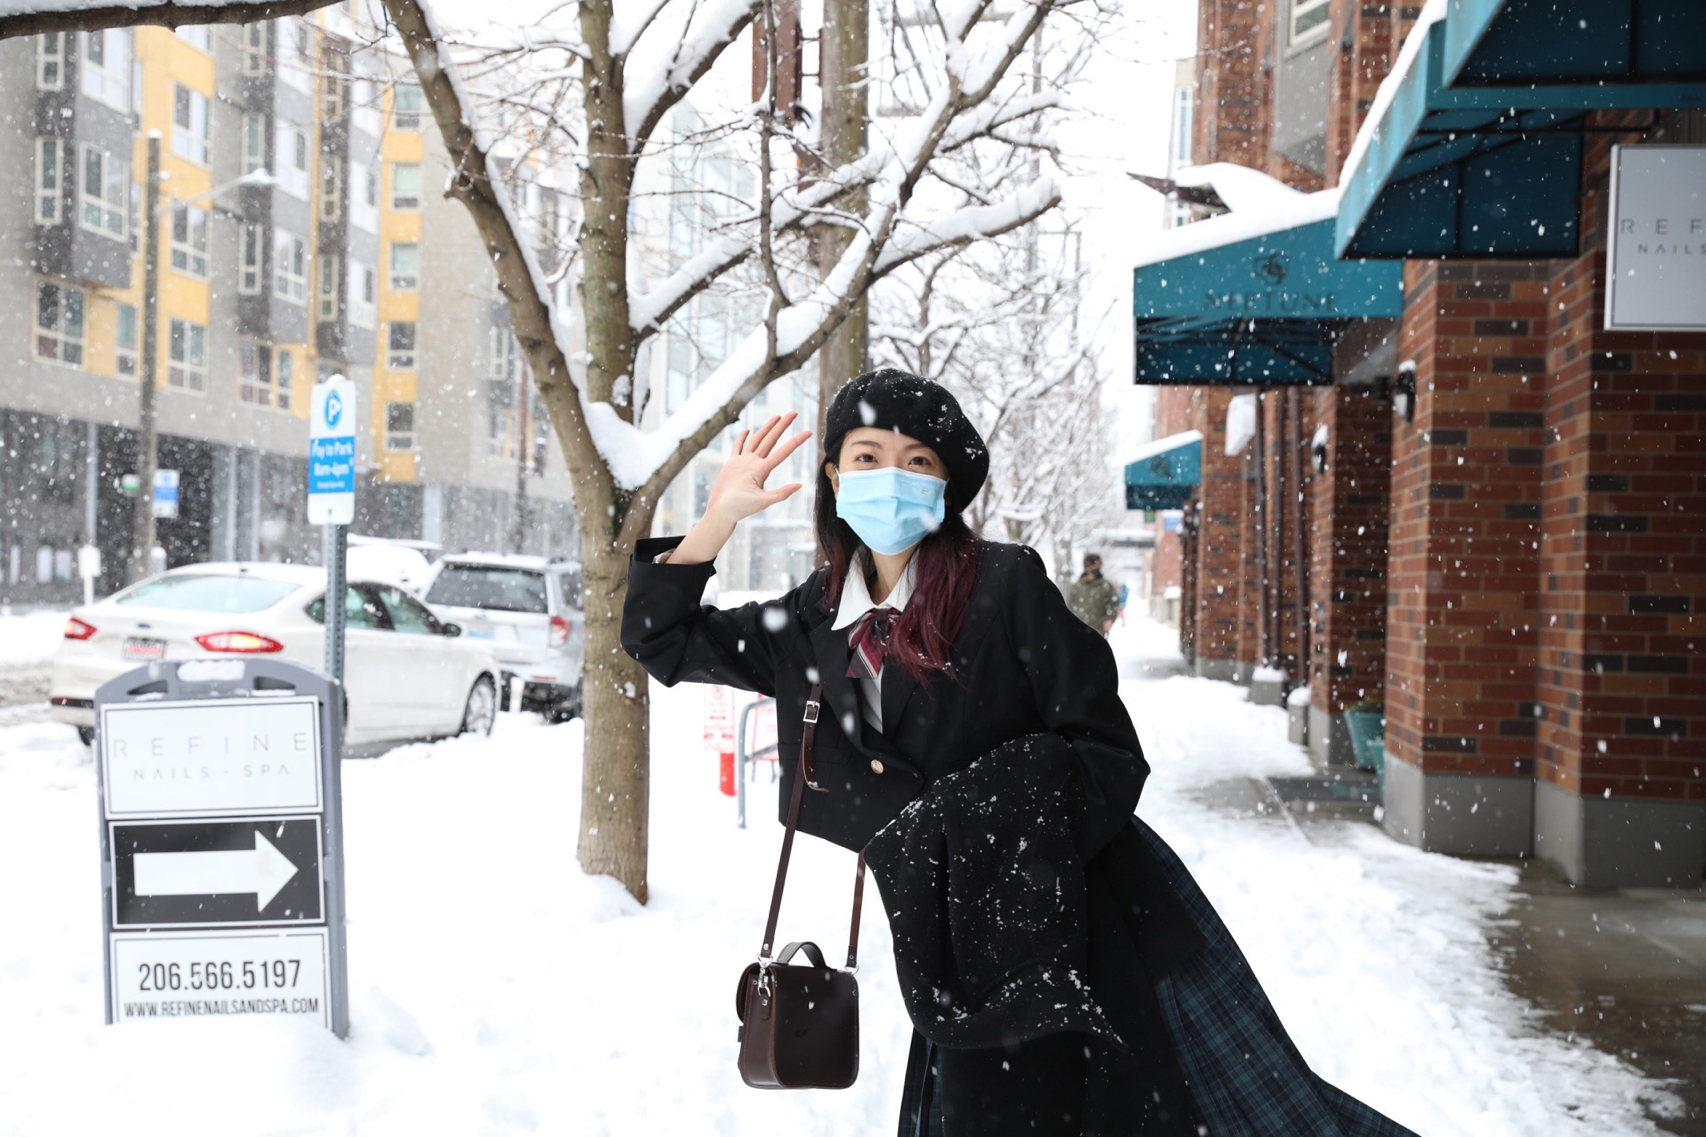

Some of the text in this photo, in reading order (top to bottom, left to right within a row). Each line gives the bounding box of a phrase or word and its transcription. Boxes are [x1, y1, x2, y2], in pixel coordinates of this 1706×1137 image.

[1620, 218, 1703, 235] REF
[1203, 290, 1338, 313] NEPTUNE
[312, 441, 352, 460] Pay to Park
[113, 732, 308, 758] REFINE
[133, 766, 211, 781] NAILS
[244, 764, 289, 778] SPA
[138, 959, 301, 992] 206.566.5197
[124, 998, 319, 1018] WWW.REFINENAILSANDSPA.COM
